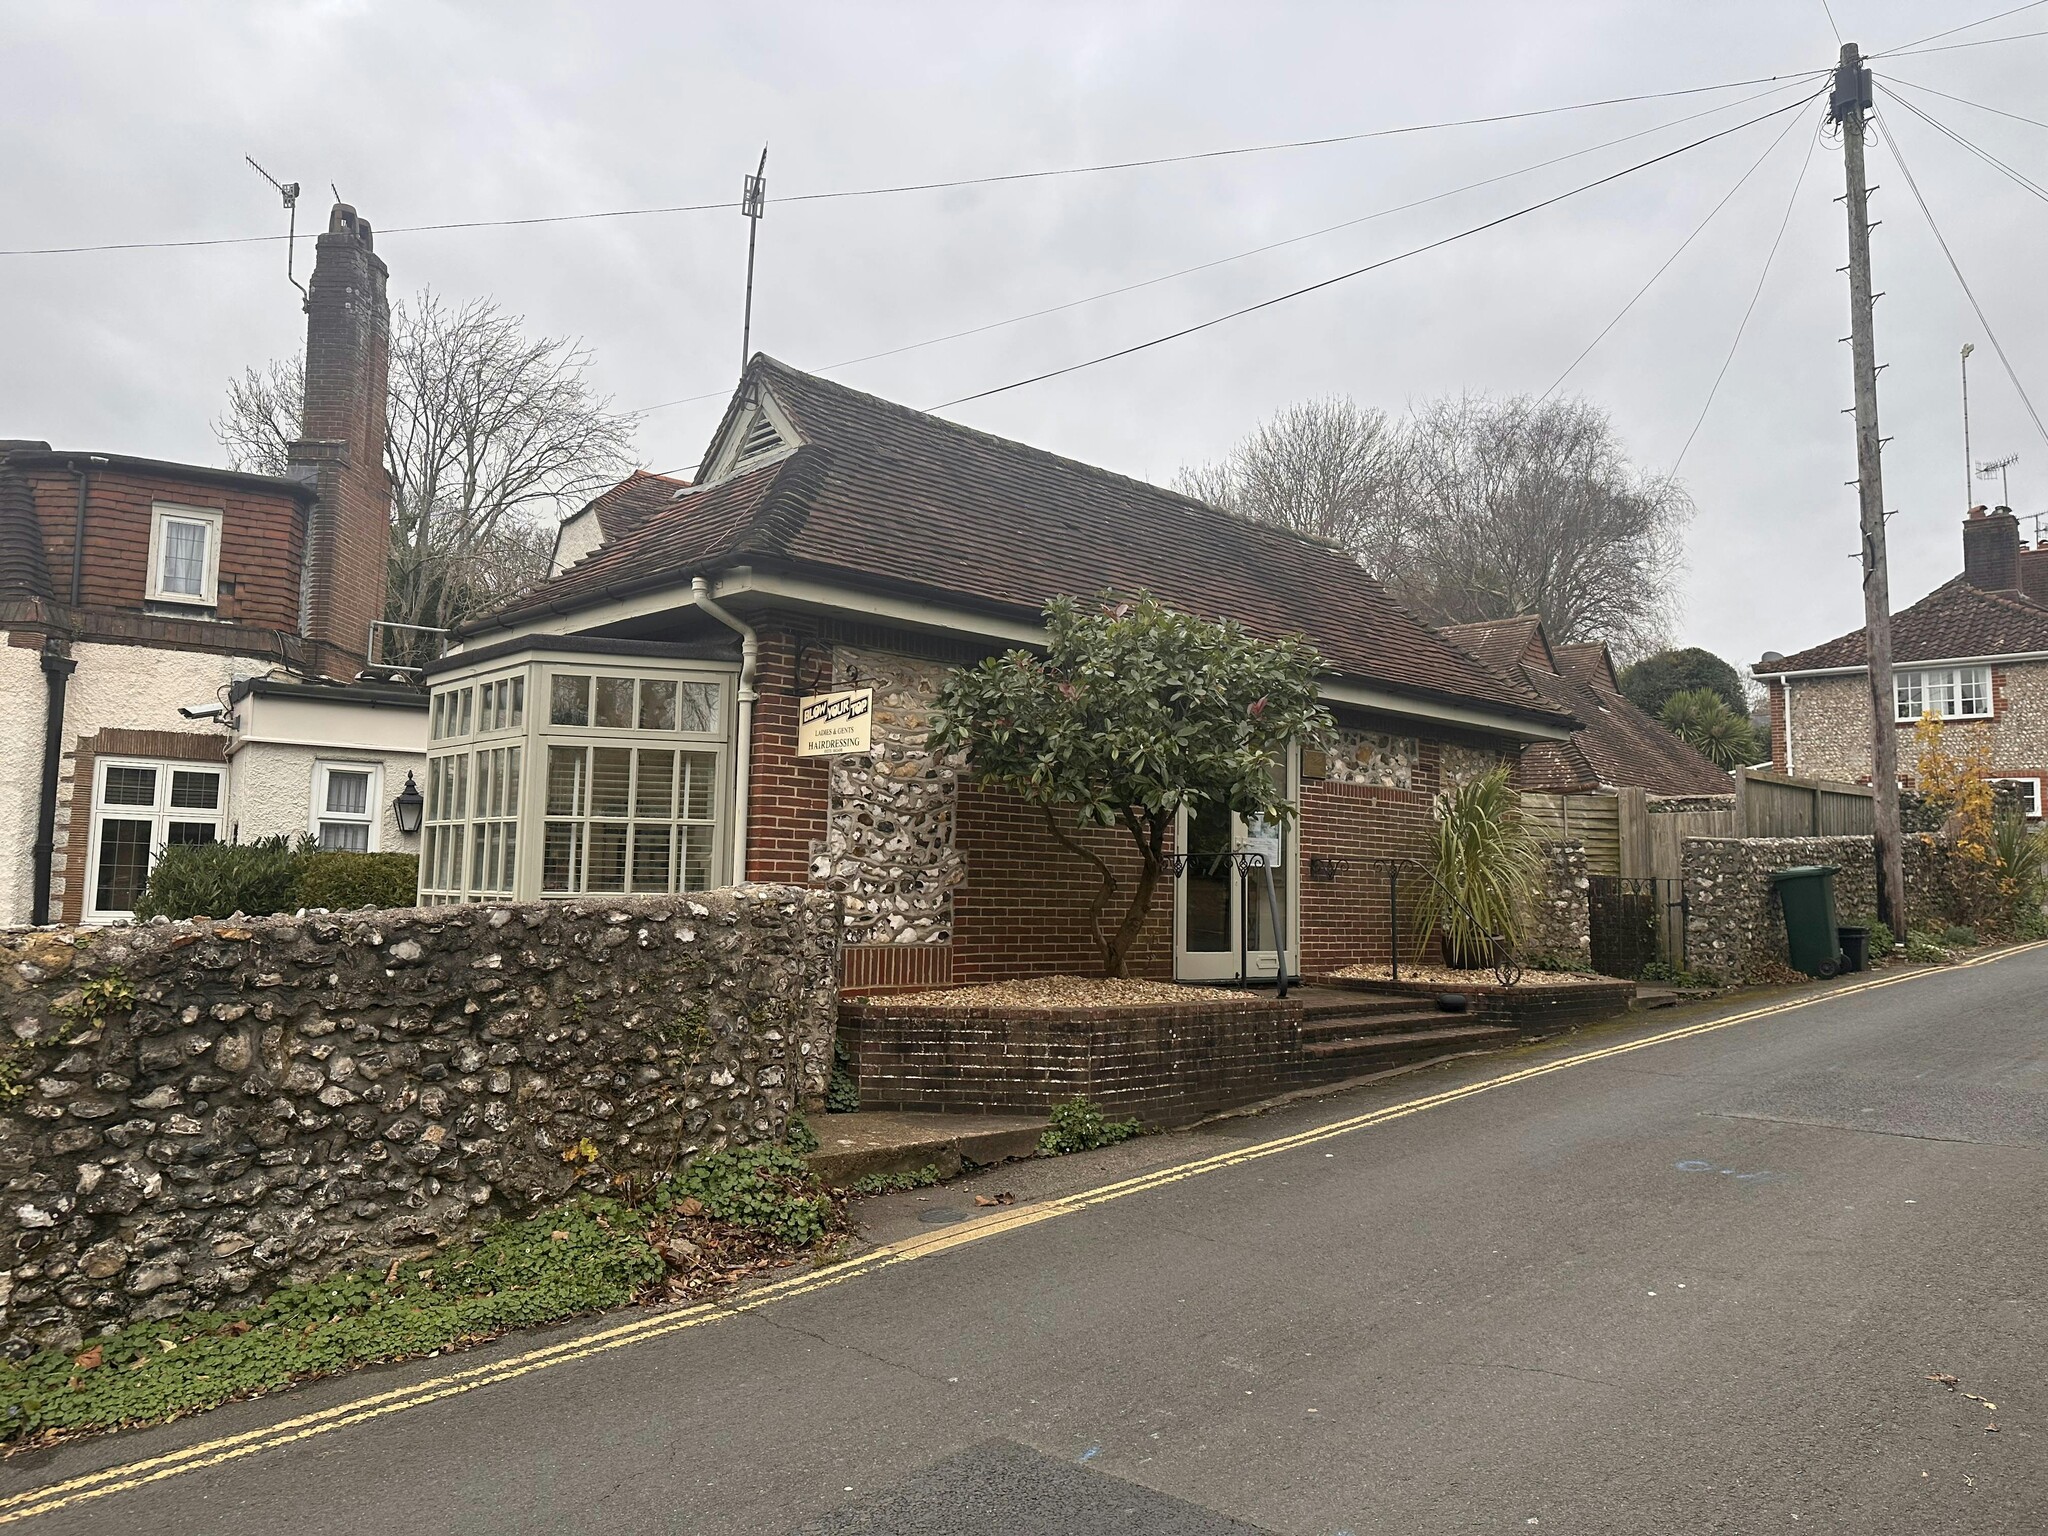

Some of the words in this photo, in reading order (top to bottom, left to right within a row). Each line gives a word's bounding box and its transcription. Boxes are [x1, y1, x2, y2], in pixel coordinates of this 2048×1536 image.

[804, 702, 827, 722] BLOW
[828, 699, 850, 719] YOUR
[815, 728, 832, 736] LADIES
[837, 727, 854, 735] GENTS
[808, 738, 860, 750] HAIRDRESSING
